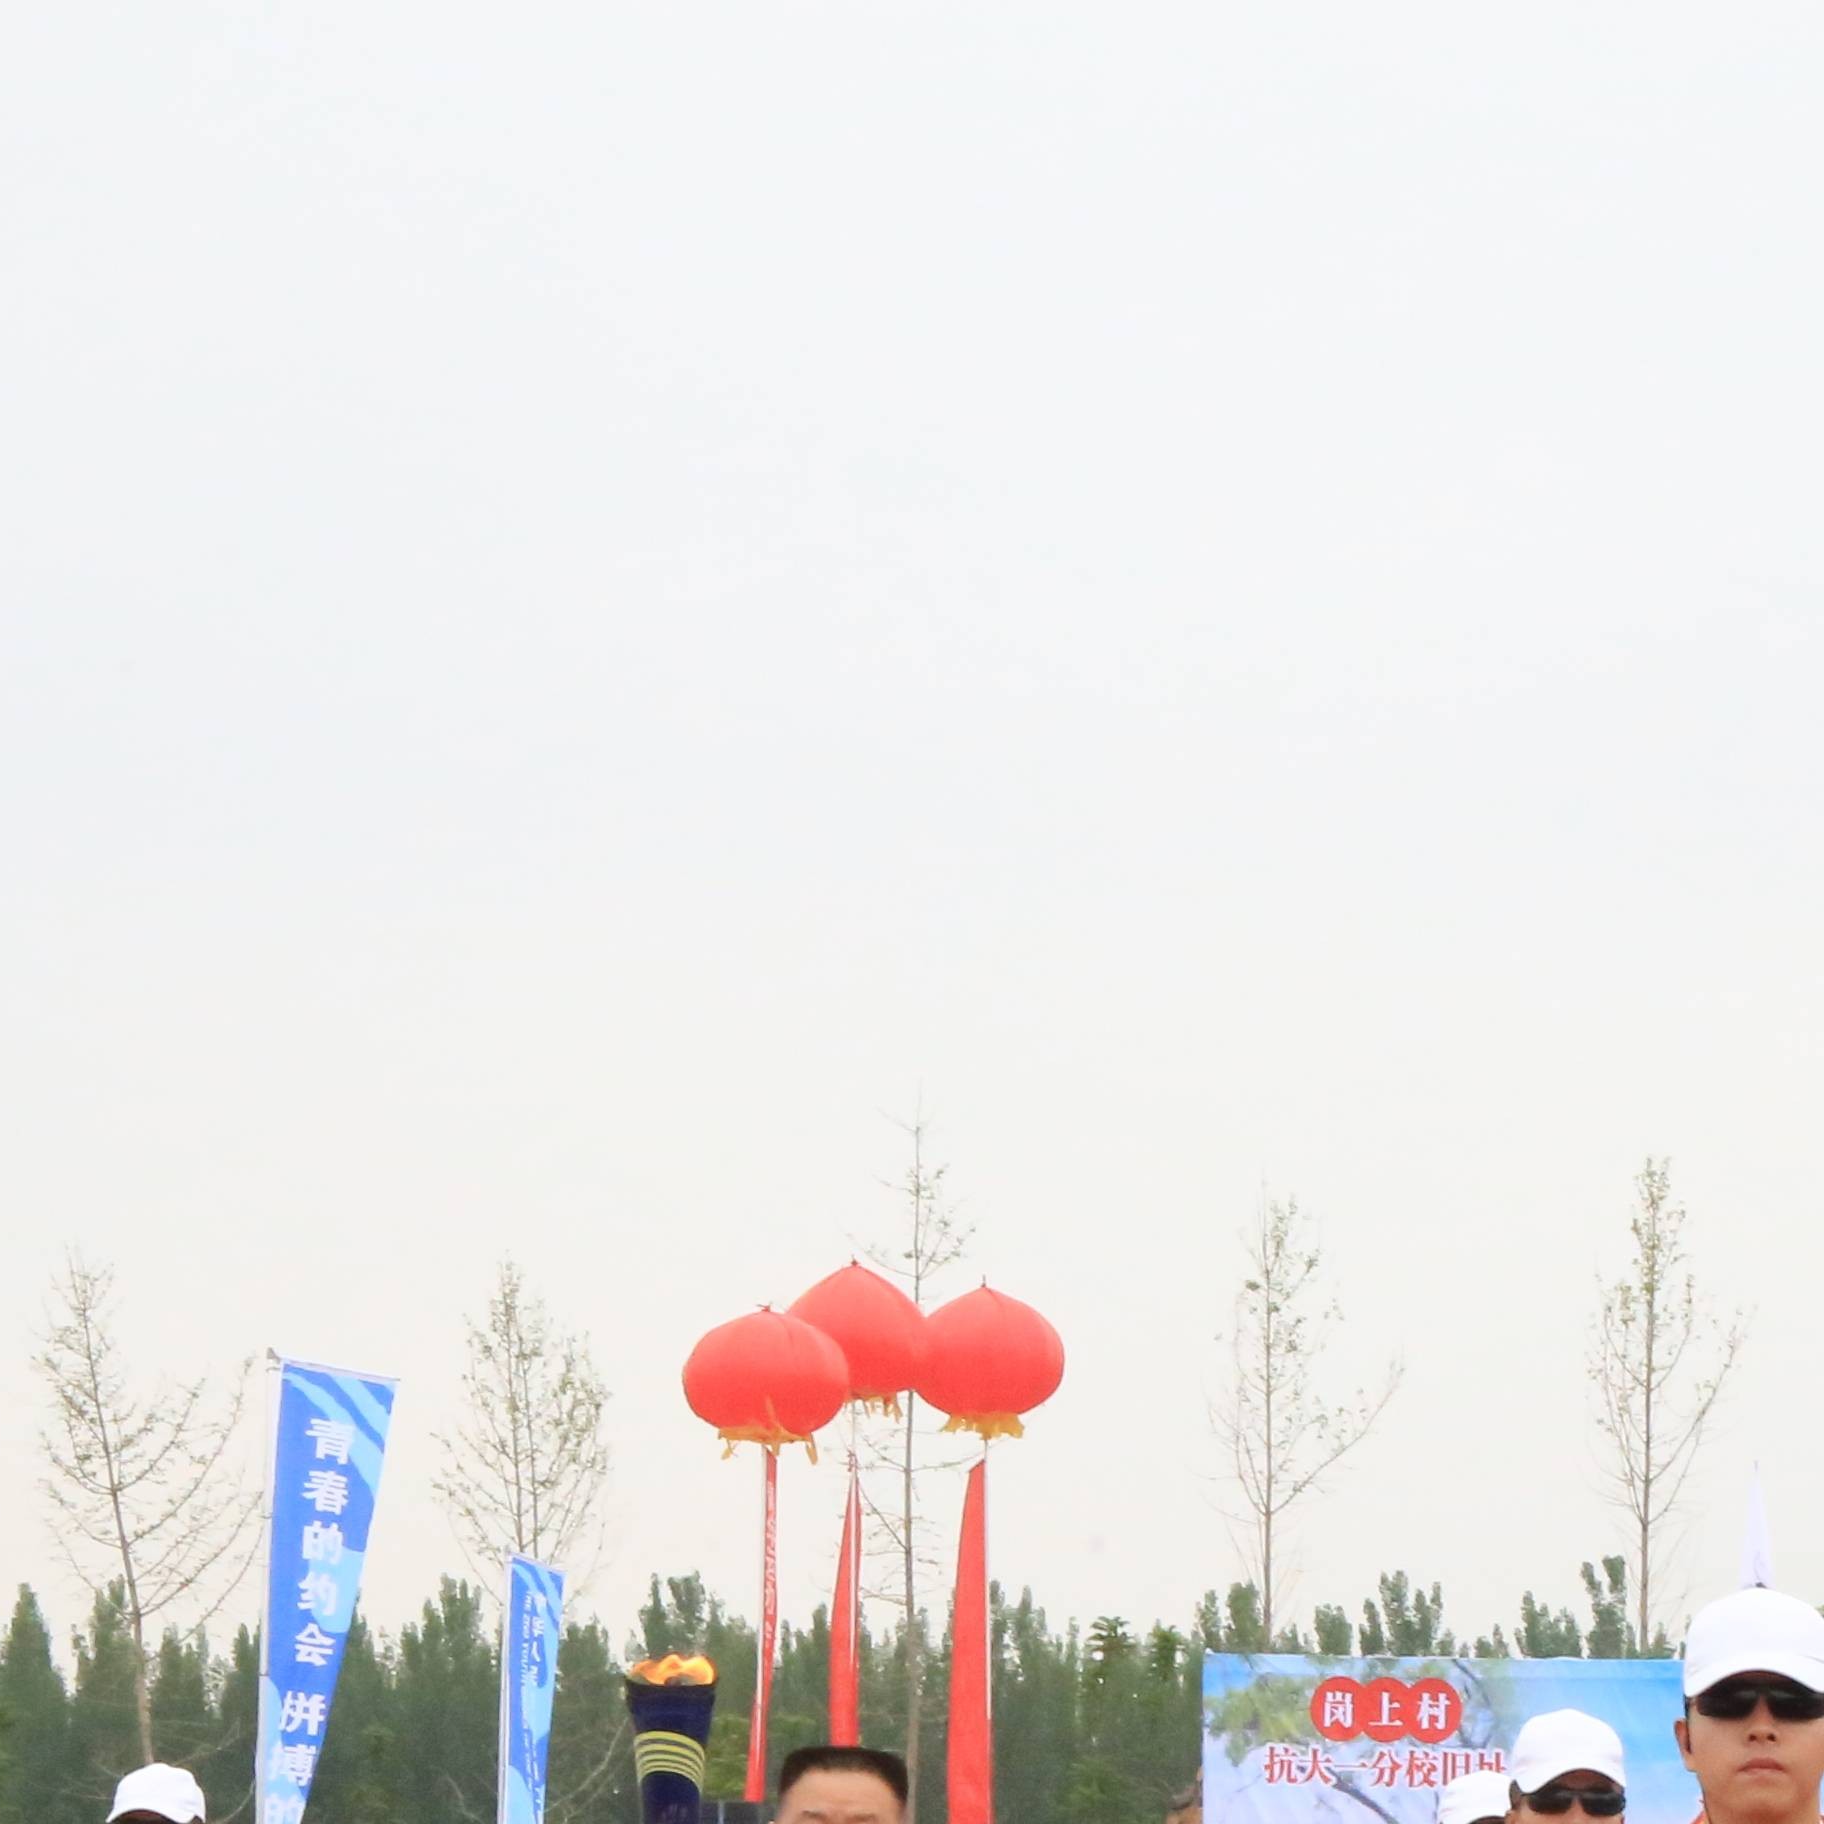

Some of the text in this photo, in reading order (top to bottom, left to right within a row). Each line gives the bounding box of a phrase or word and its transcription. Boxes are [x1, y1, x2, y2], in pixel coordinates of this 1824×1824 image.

[294, 1417, 356, 1667] 青春的约会
[1323, 1690, 1451, 1730] 岗上村
